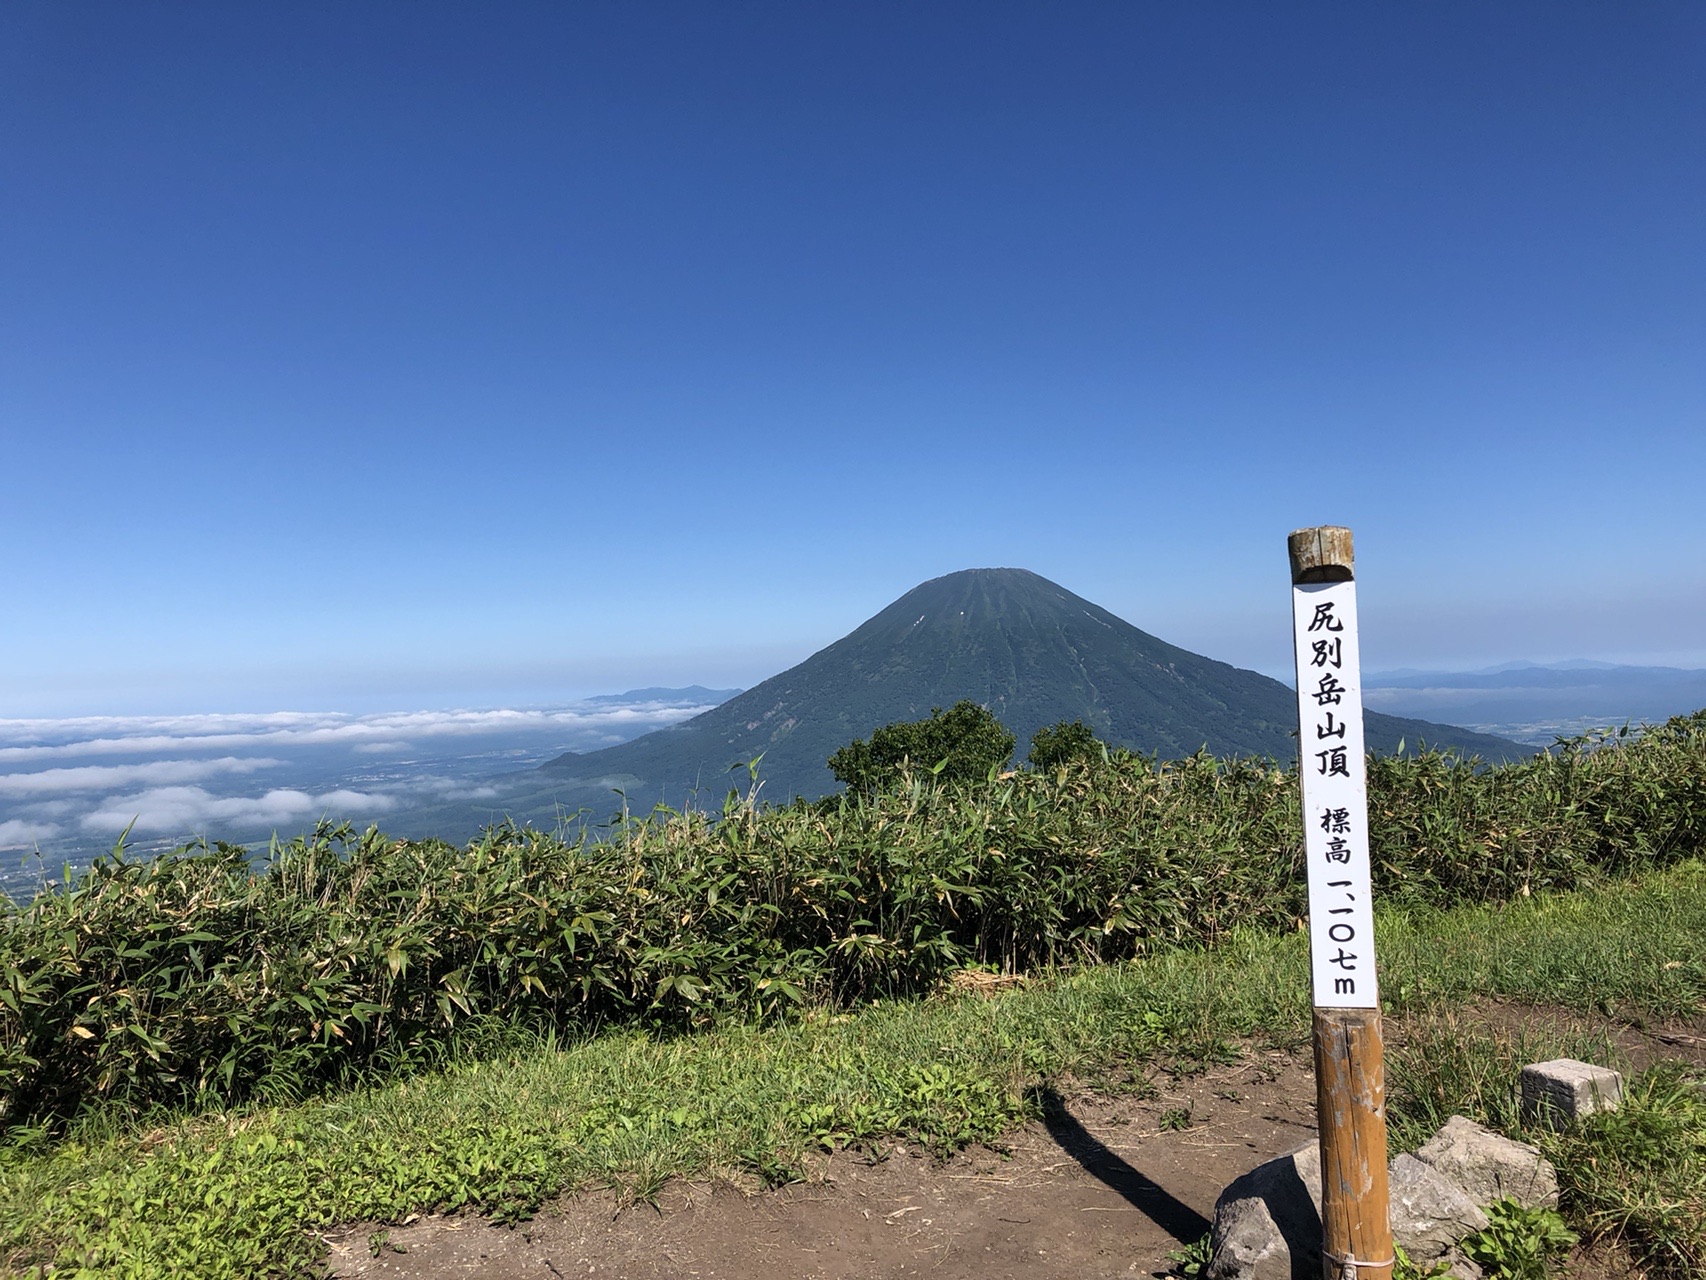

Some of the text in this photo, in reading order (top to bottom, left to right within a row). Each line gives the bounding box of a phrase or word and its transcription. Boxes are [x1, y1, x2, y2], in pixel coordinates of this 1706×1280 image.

[1307, 601, 1350, 778] 尻別岳山頂
